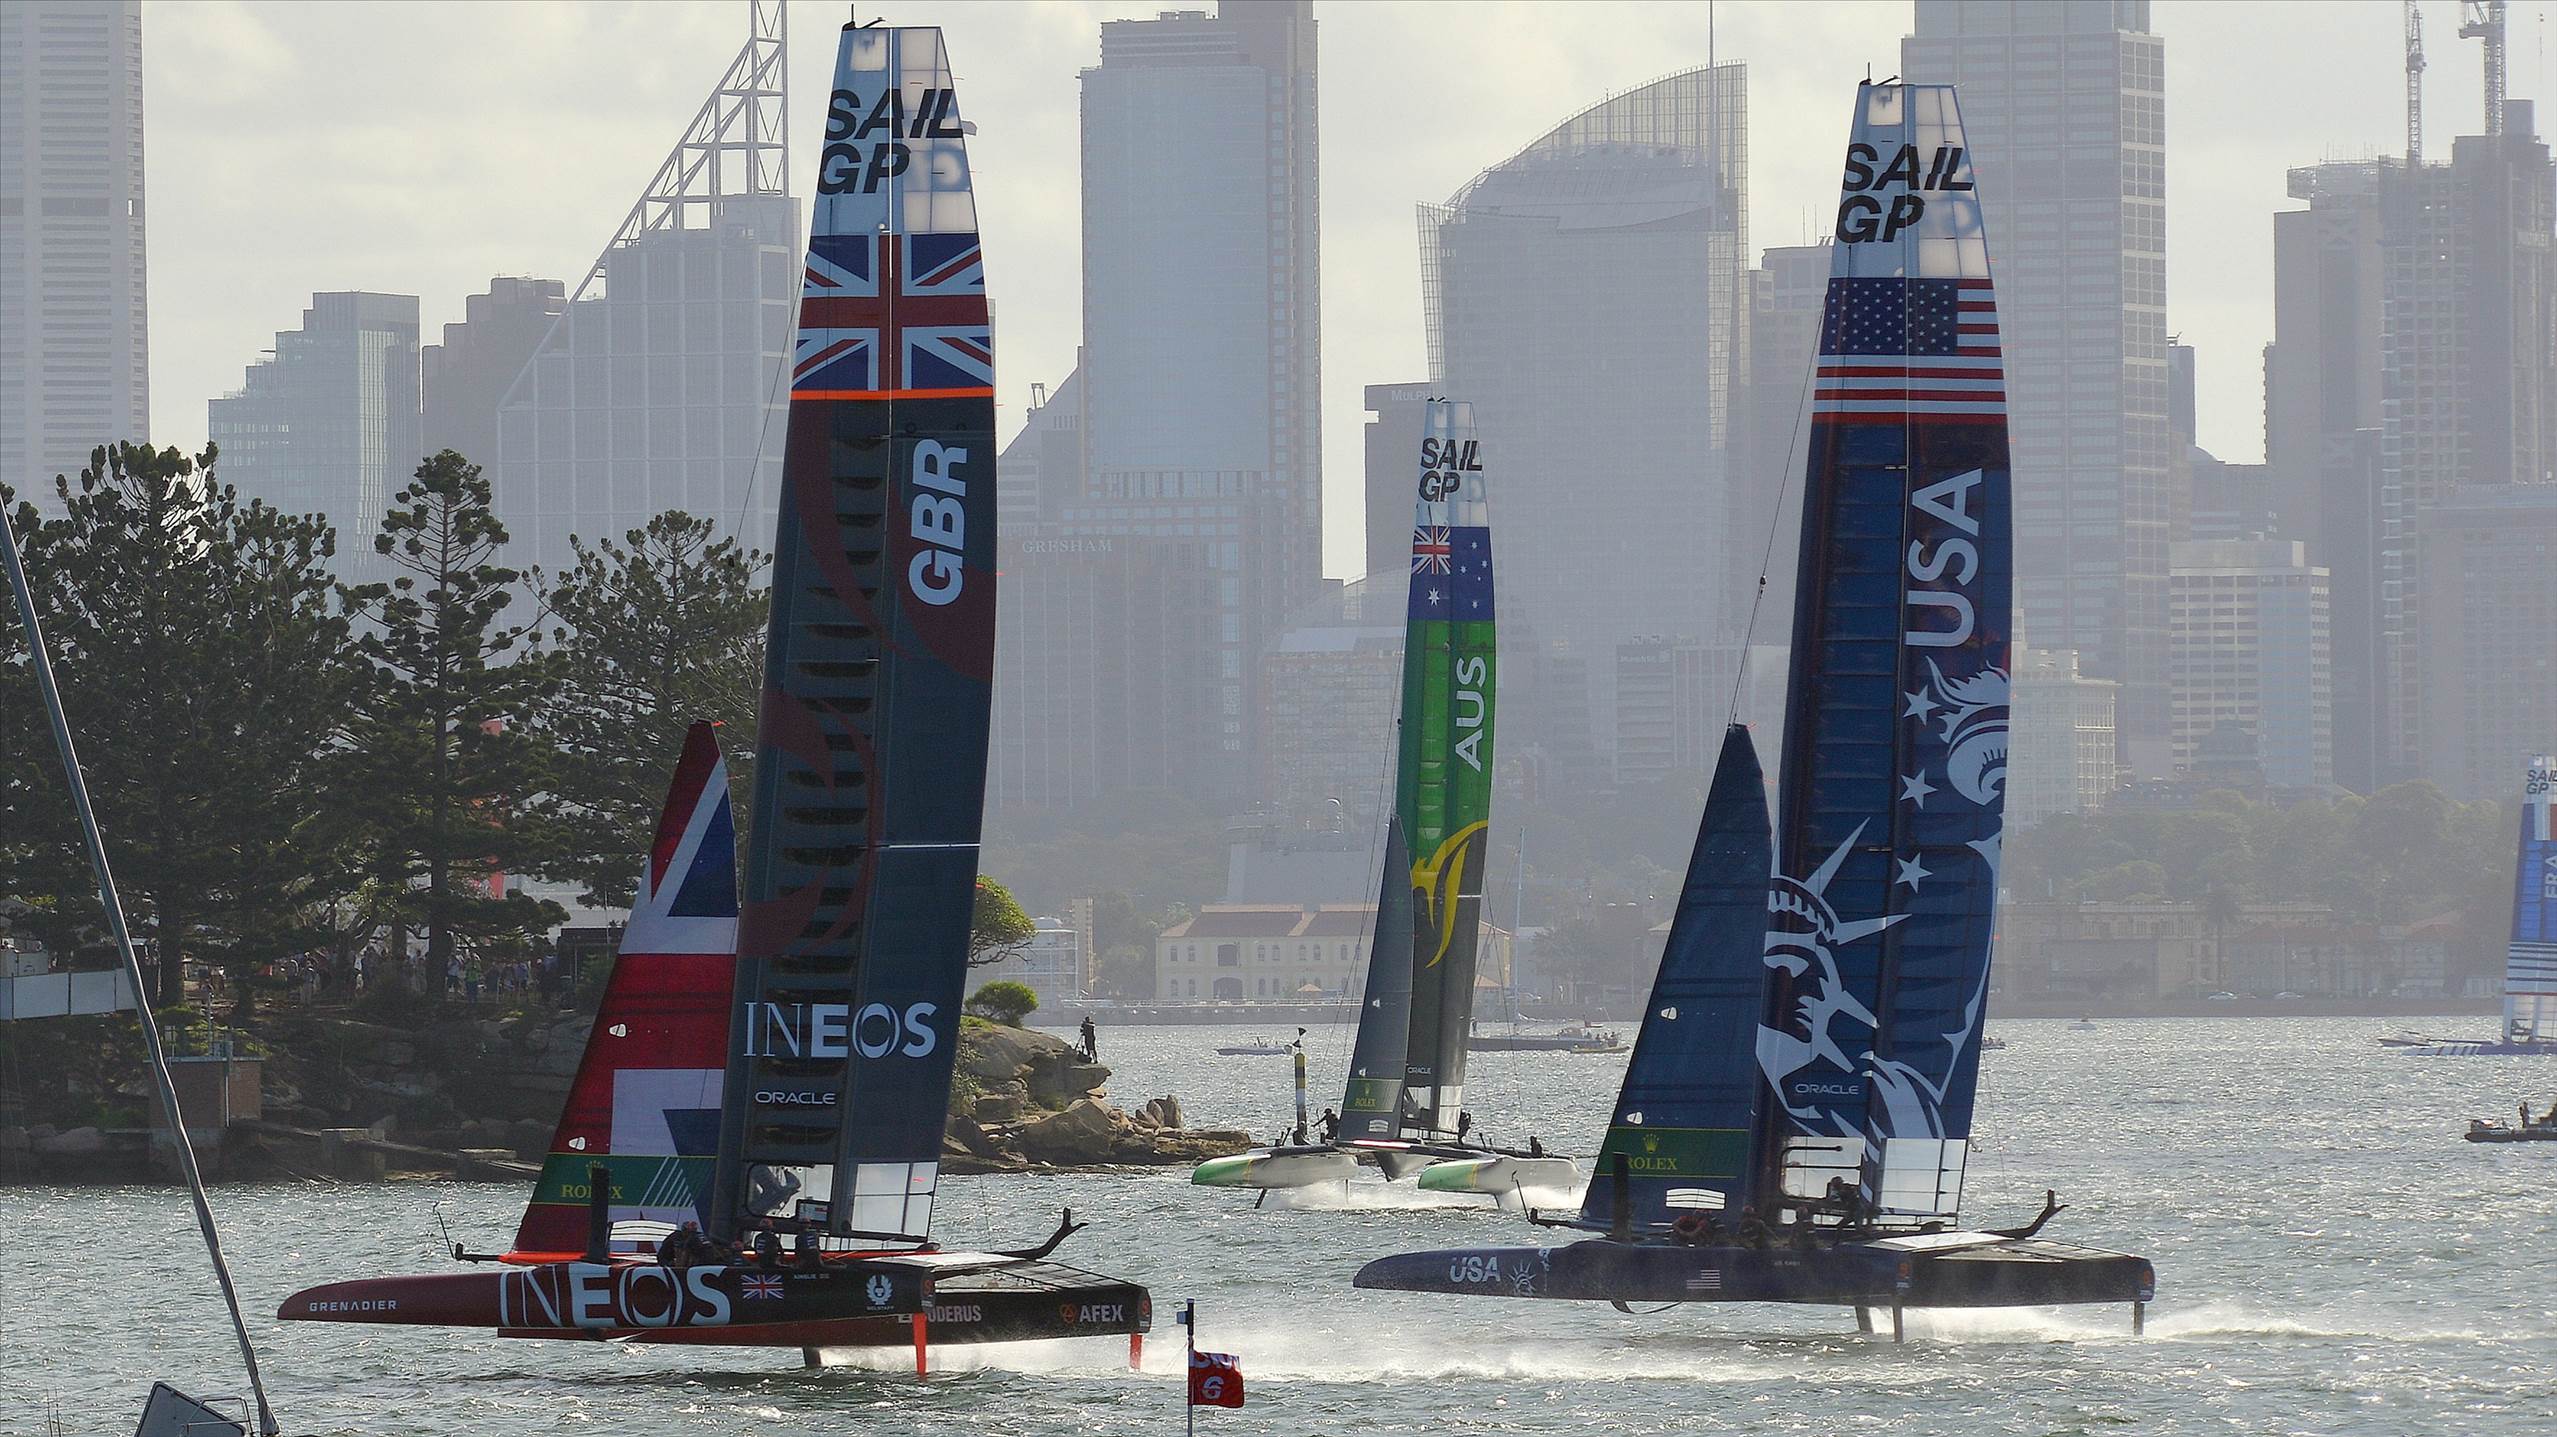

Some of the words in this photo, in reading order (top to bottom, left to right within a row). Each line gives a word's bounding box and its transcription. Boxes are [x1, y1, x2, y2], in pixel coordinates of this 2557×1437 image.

[825, 88, 963, 140] SAIL
[817, 143, 911, 194] GP
[1842, 143, 1974, 192] SAIL
[1835, 194, 1925, 243] GP
[1420, 437, 1483, 471] SAIL
[1418, 470, 1460, 502] GP
[908, 438, 968, 606] GBR
[1022, 538, 1113, 553] GRESHAM
[1905, 467, 1983, 648] USA
[1455, 656, 1487, 773] AUS
[2526, 782, 2550, 794] GP
[743, 1002, 937, 1059] INEOS
[754, 1090, 837, 1105] ORACLE
[1795, 1083, 1859, 1095] ORACLE
[561, 1184, 624, 1200] ROX
[1449, 1256, 1501, 1283] USA
[309, 1300, 397, 1312] GRENADIER
[500, 1263, 732, 1328] INEOS
[927, 1305, 983, 1323] ODERUS
[1080, 1304, 1124, 1322] AFEX
